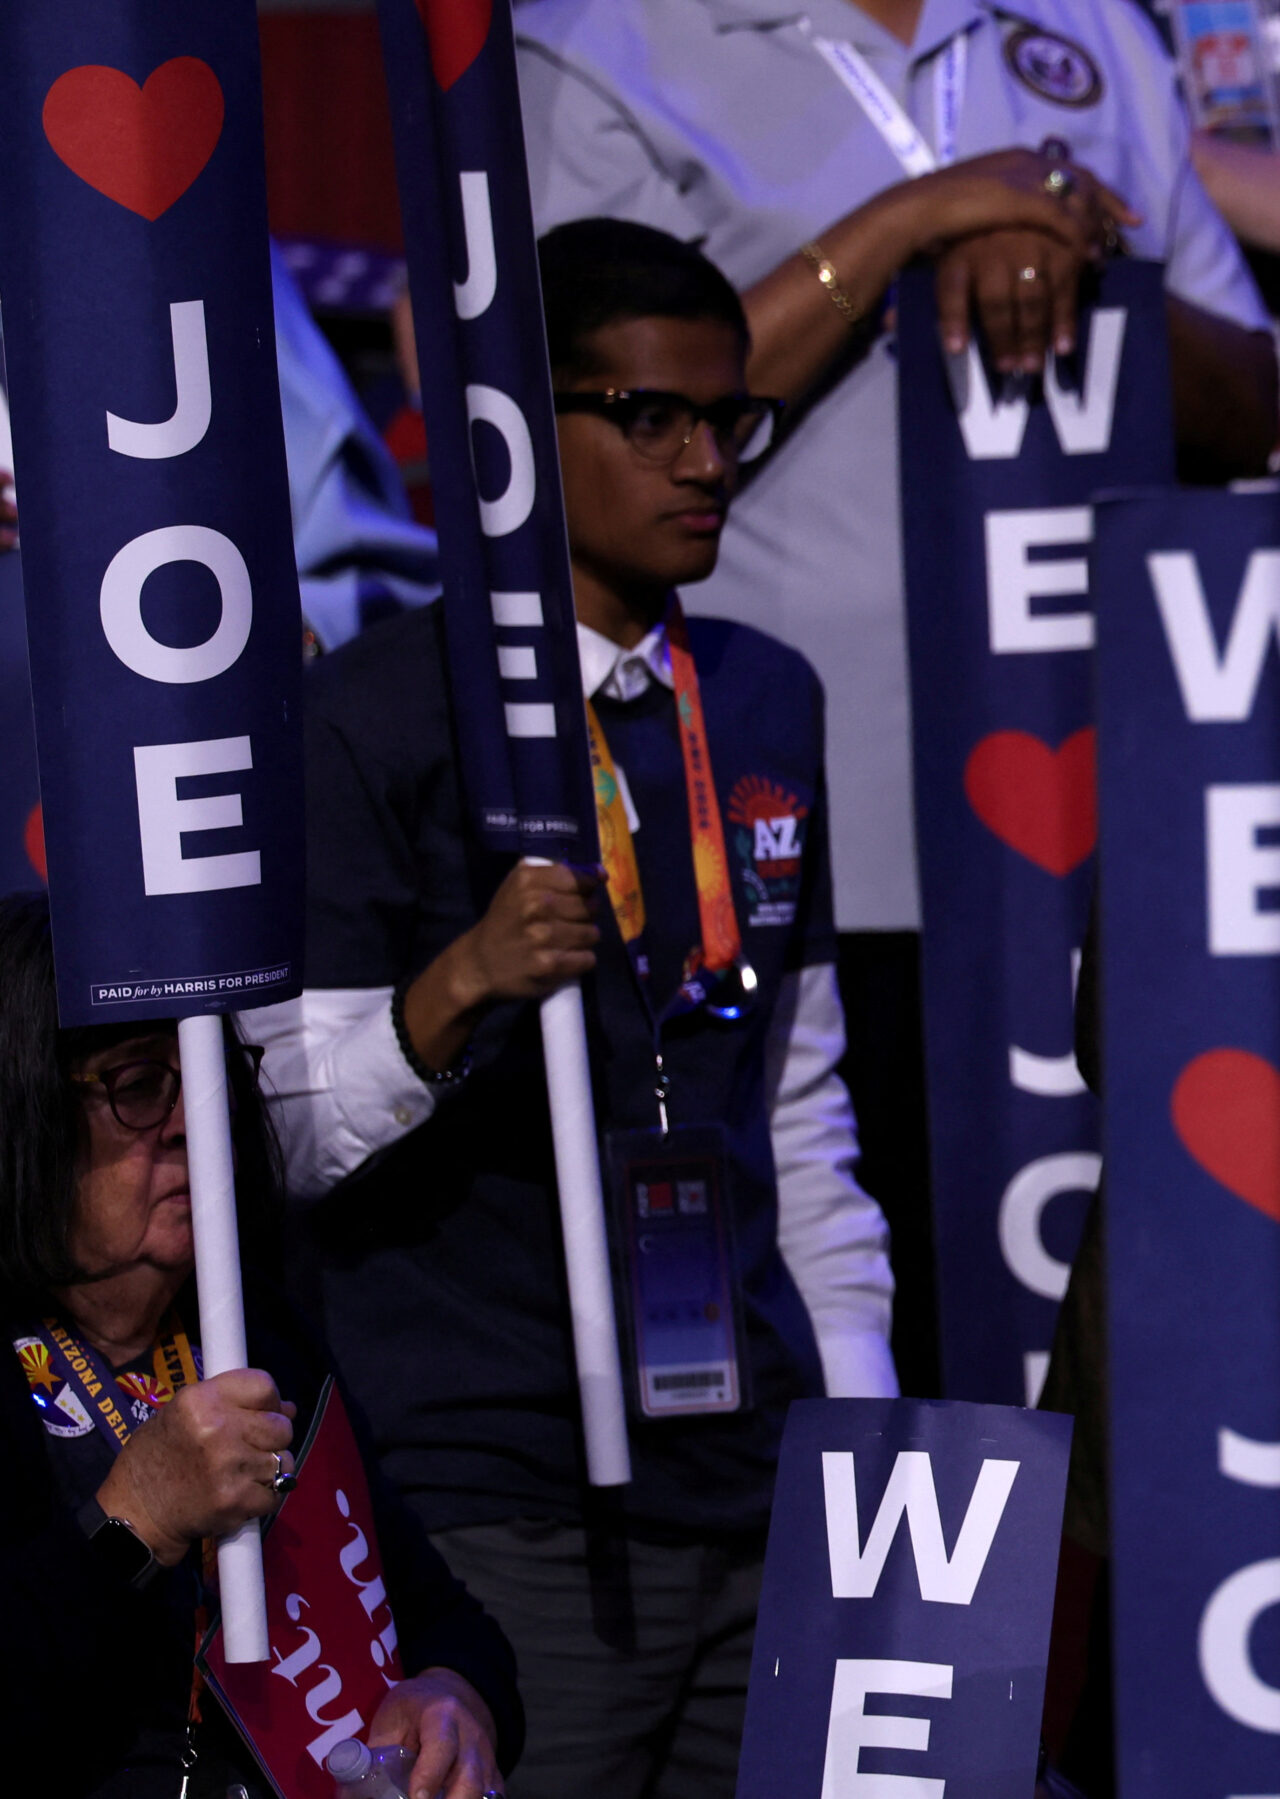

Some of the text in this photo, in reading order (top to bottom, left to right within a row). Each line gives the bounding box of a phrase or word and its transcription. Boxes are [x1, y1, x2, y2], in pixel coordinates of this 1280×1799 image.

[943, 307, 1128, 656] WE
[100, 299, 262, 896] JOE
[754, 814, 801, 861] AZ
[98, 967, 289, 999] PAID for by HARRIS FOR PRESIDENT
[42, 1317, 104, 1398] ARIZONA
[820, 1451, 1021, 1799] WE
